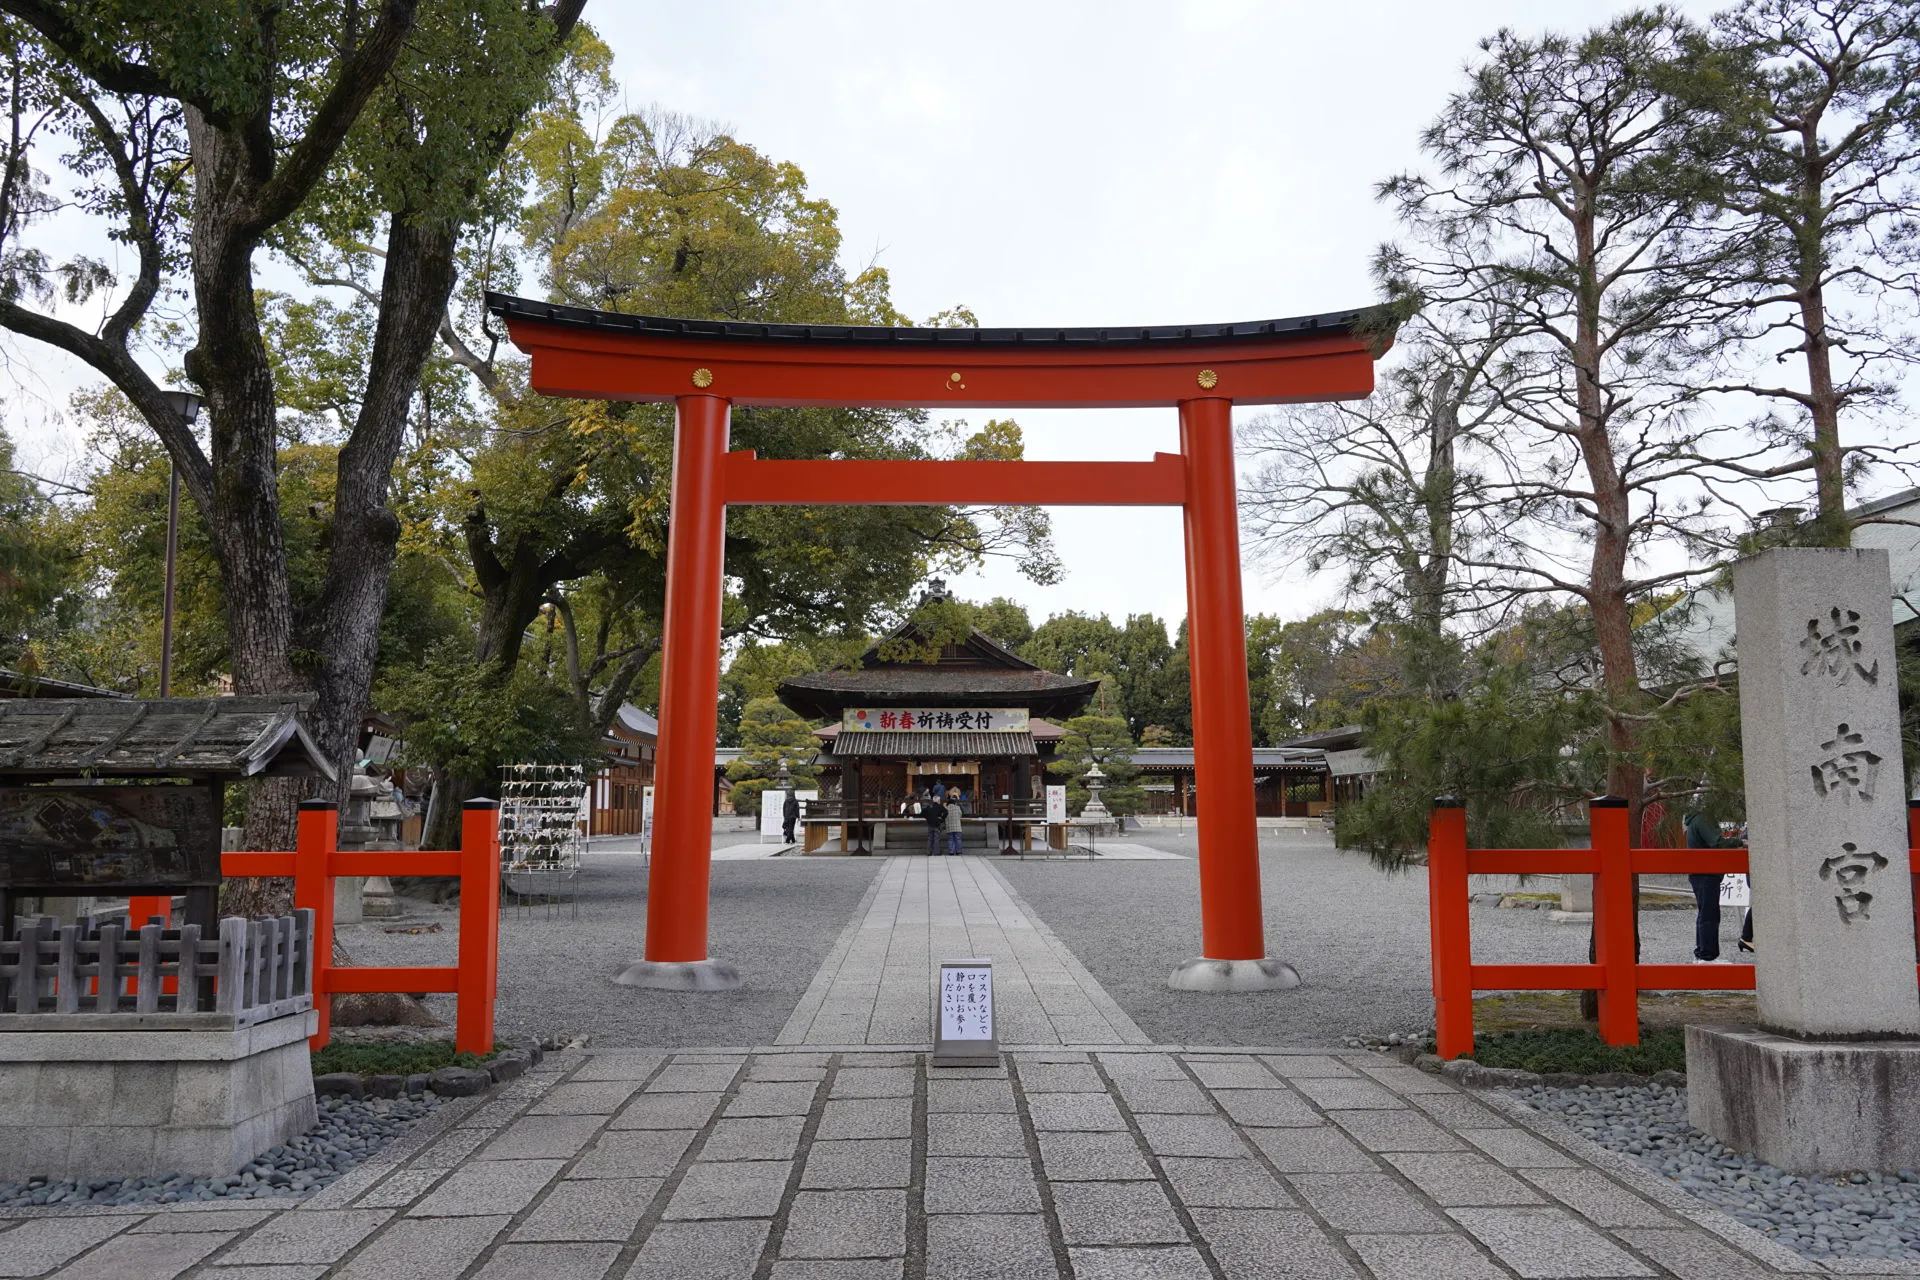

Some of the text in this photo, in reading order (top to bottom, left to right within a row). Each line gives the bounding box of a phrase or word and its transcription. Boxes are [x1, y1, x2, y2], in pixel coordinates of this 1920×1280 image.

[879, 711, 993, 729] 新春祈祷受付
[1799, 606, 1889, 926] 城南宮
[945, 973, 954, 1018] ください。
[956, 972, 965, 1034] 静かにお参り
[967, 974, 976, 1018] 口を覆い、
[978, 974, 988, 1033] マスクなどで
